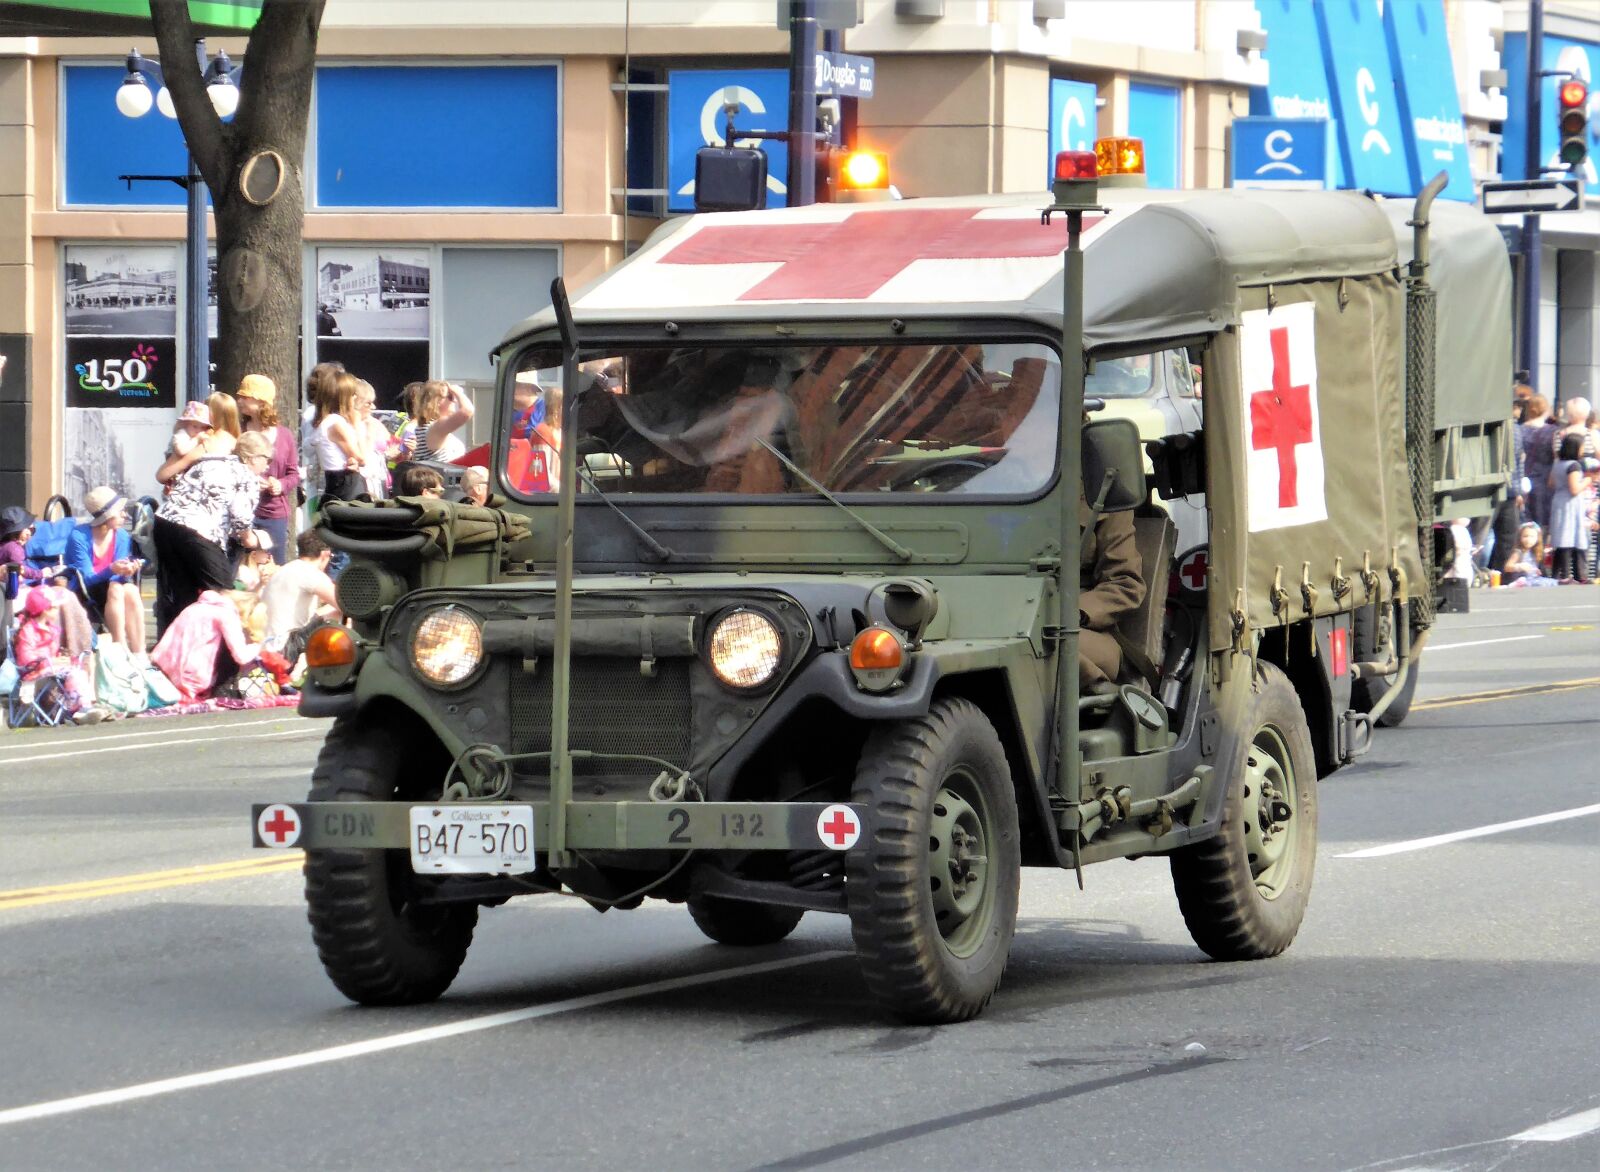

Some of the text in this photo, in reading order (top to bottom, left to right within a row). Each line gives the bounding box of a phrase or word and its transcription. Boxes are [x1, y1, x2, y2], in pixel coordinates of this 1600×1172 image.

[823, 58, 856, 88] Douglas
[84, 359, 147, 391] 150
[324, 813, 375, 836] CDN
[451, 810, 493, 821] Collector
[668, 808, 764, 843] 2 132
